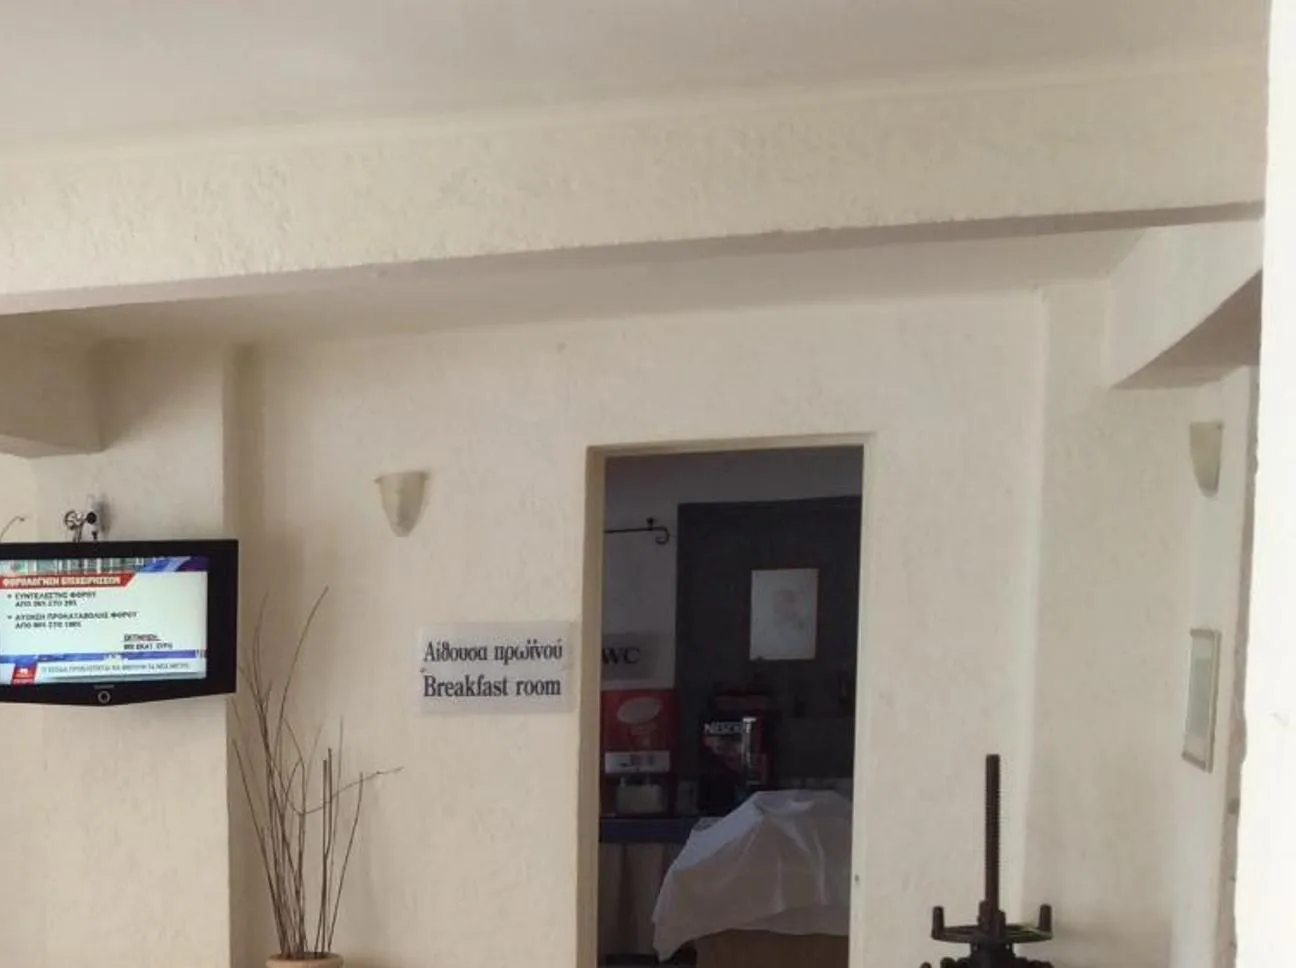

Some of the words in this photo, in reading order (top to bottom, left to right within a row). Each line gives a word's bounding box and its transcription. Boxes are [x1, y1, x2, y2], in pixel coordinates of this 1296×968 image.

[423, 640, 489, 662] Αίθουσα
[602, 646, 641, 665] WC
[423, 674, 509, 697] Breakfast
[515, 678, 562, 696] room
